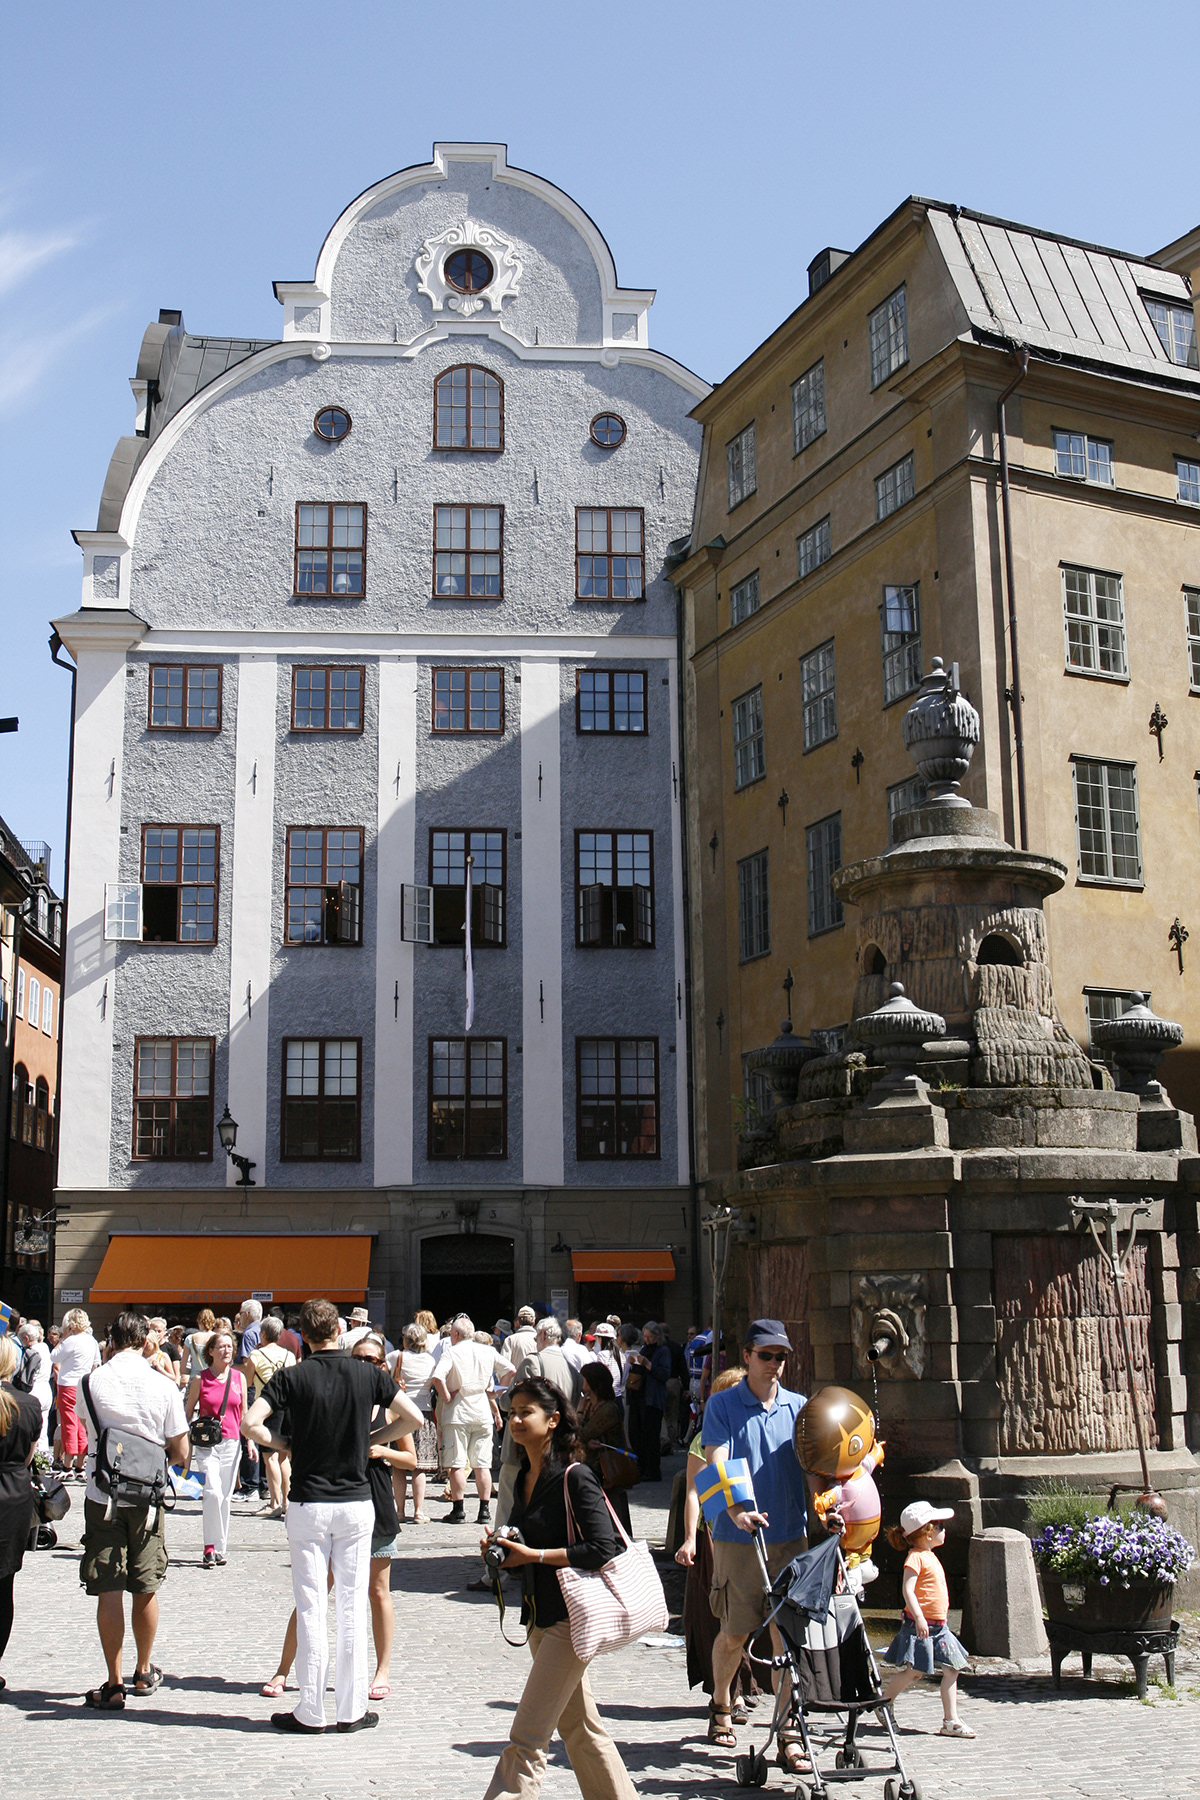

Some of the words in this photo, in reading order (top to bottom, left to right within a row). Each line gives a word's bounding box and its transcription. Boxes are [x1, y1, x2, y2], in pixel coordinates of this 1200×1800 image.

[490, 1209, 496, 1219] 3
[182, 1292, 201, 1301] Café
[203, 1293, 209, 1301] &
